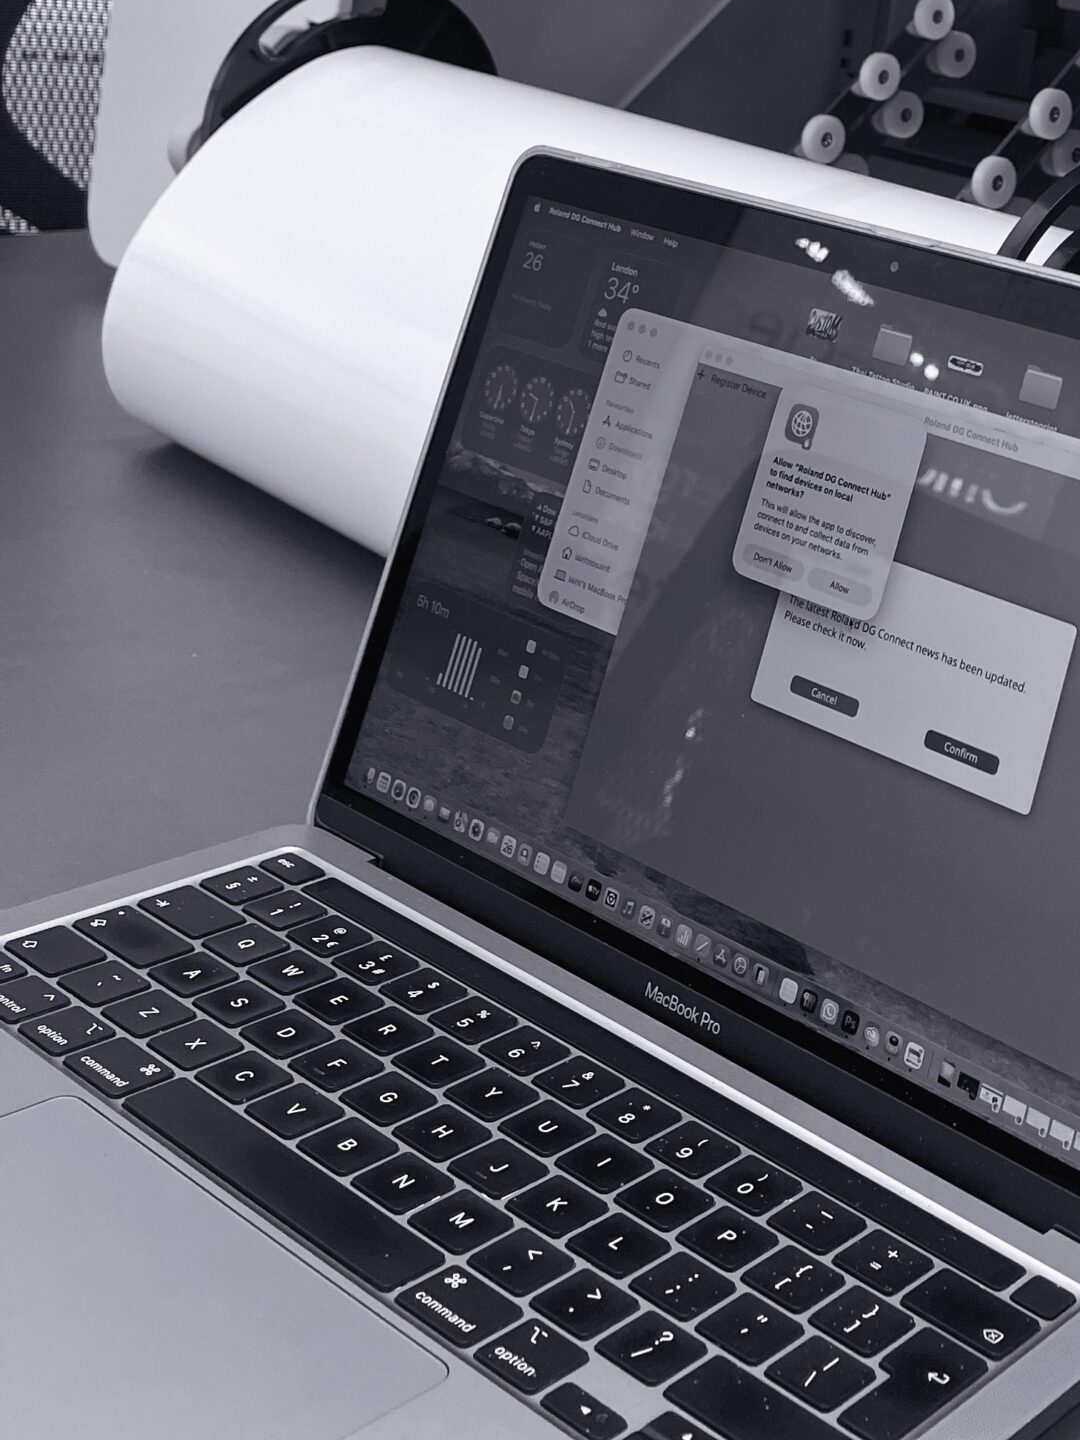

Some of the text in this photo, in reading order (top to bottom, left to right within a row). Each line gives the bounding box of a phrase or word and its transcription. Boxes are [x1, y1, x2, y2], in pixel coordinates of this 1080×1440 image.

[581, 216, 607, 229] Connect
[608, 223, 621, 232] Hub
[631, 229, 654, 240] Window
[664, 237, 678, 248] Help
[522, 252, 544, 271] 26
[611, 262, 638, 277] London
[636, 355, 660, 369] Recents
[629, 377, 651, 390] Shared
[711, 374, 766, 399] Register Device
[892, 378, 915, 391] Studio
[615, 421, 653, 439] Applications
[924, 417, 1019, 452] Roland DG Connect Hub
[602, 465, 628, 480] Desktop
[773, 456, 793, 470] Allow
[824, 473, 837, 483] DG
[838, 478, 869, 494] Connect
[766, 480, 804, 498] networks?
[770, 468, 853, 502] to find devices on local
[595, 486, 630, 505] Documents
[761, 498, 876, 547] This will allow the app to discover,
[757, 511, 869, 556] connect to and collect data from
[582, 531, 619, 551] iCloud Drive
[754, 522, 842, 560] devices on your networks.
[754, 552, 792, 573] Don't Allow
[588, 583, 616, 601] MacBook
[830, 581, 849, 594] Allow
[432, 600, 450, 618] 10m
[561, 598, 585, 614] AirDrop
[784, 610, 867, 650] Please check it now.
[789, 594, 1026, 694] The latest Roland DG Connect news has been updated.
[811, 688, 838, 706] Cancel
[944, 741, 978, 763] Confirm
[503, 841, 513, 855] 26
[270, 908, 284, 916] 1
[237, 939, 256, 950] Q
[311, 934, 331, 944] 2
[281, 964, 305, 977] W
[358, 960, 377, 971] 3
[182, 969, 202, 980] A
[329, 995, 349, 1005] E
[407, 990, 424, 998] 4
[0, 994, 27, 1014] ontrol
[230, 997, 249, 1008] S
[644, 981, 721, 1035] MacBook Pro
[138, 1006, 160, 1018] Z
[377, 1023, 397, 1035] R
[456, 1017, 475, 1028] 5
[845, 1015, 857, 1031] Ps
[37, 1024, 68, 1046] option
[276, 1026, 296, 1038] D
[184, 1037, 207, 1050] X
[430, 1054, 449, 1065] T
[507, 1048, 526, 1058] 6
[326, 1058, 348, 1069] F
[80, 1055, 130, 1088] command
[234, 1070, 255, 1082] C
[561, 1079, 581, 1088] 7
[379, 1092, 399, 1103] G
[484, 1086, 503, 1098] Y
[286, 1102, 307, 1115] V
[617, 1113, 636, 1124] 8
[431, 1124, 454, 1139] H
[537, 1120, 559, 1133] U
[336, 1138, 358, 1151] B
[675, 1147, 694, 1159] 9
[489, 1163, 510, 1173] J
[596, 1157, 612, 1167] I
[391, 1174, 416, 1189] N
[736, 1182, 755, 1194] 0
[545, 1197, 568, 1212] K
[655, 1192, 675, 1205] O
[448, 1211, 475, 1229] M
[716, 1229, 737, 1241] P
[608, 1236, 624, 1251] L
[415, 1291, 477, 1333] command
[494, 1346, 536, 1377] option
